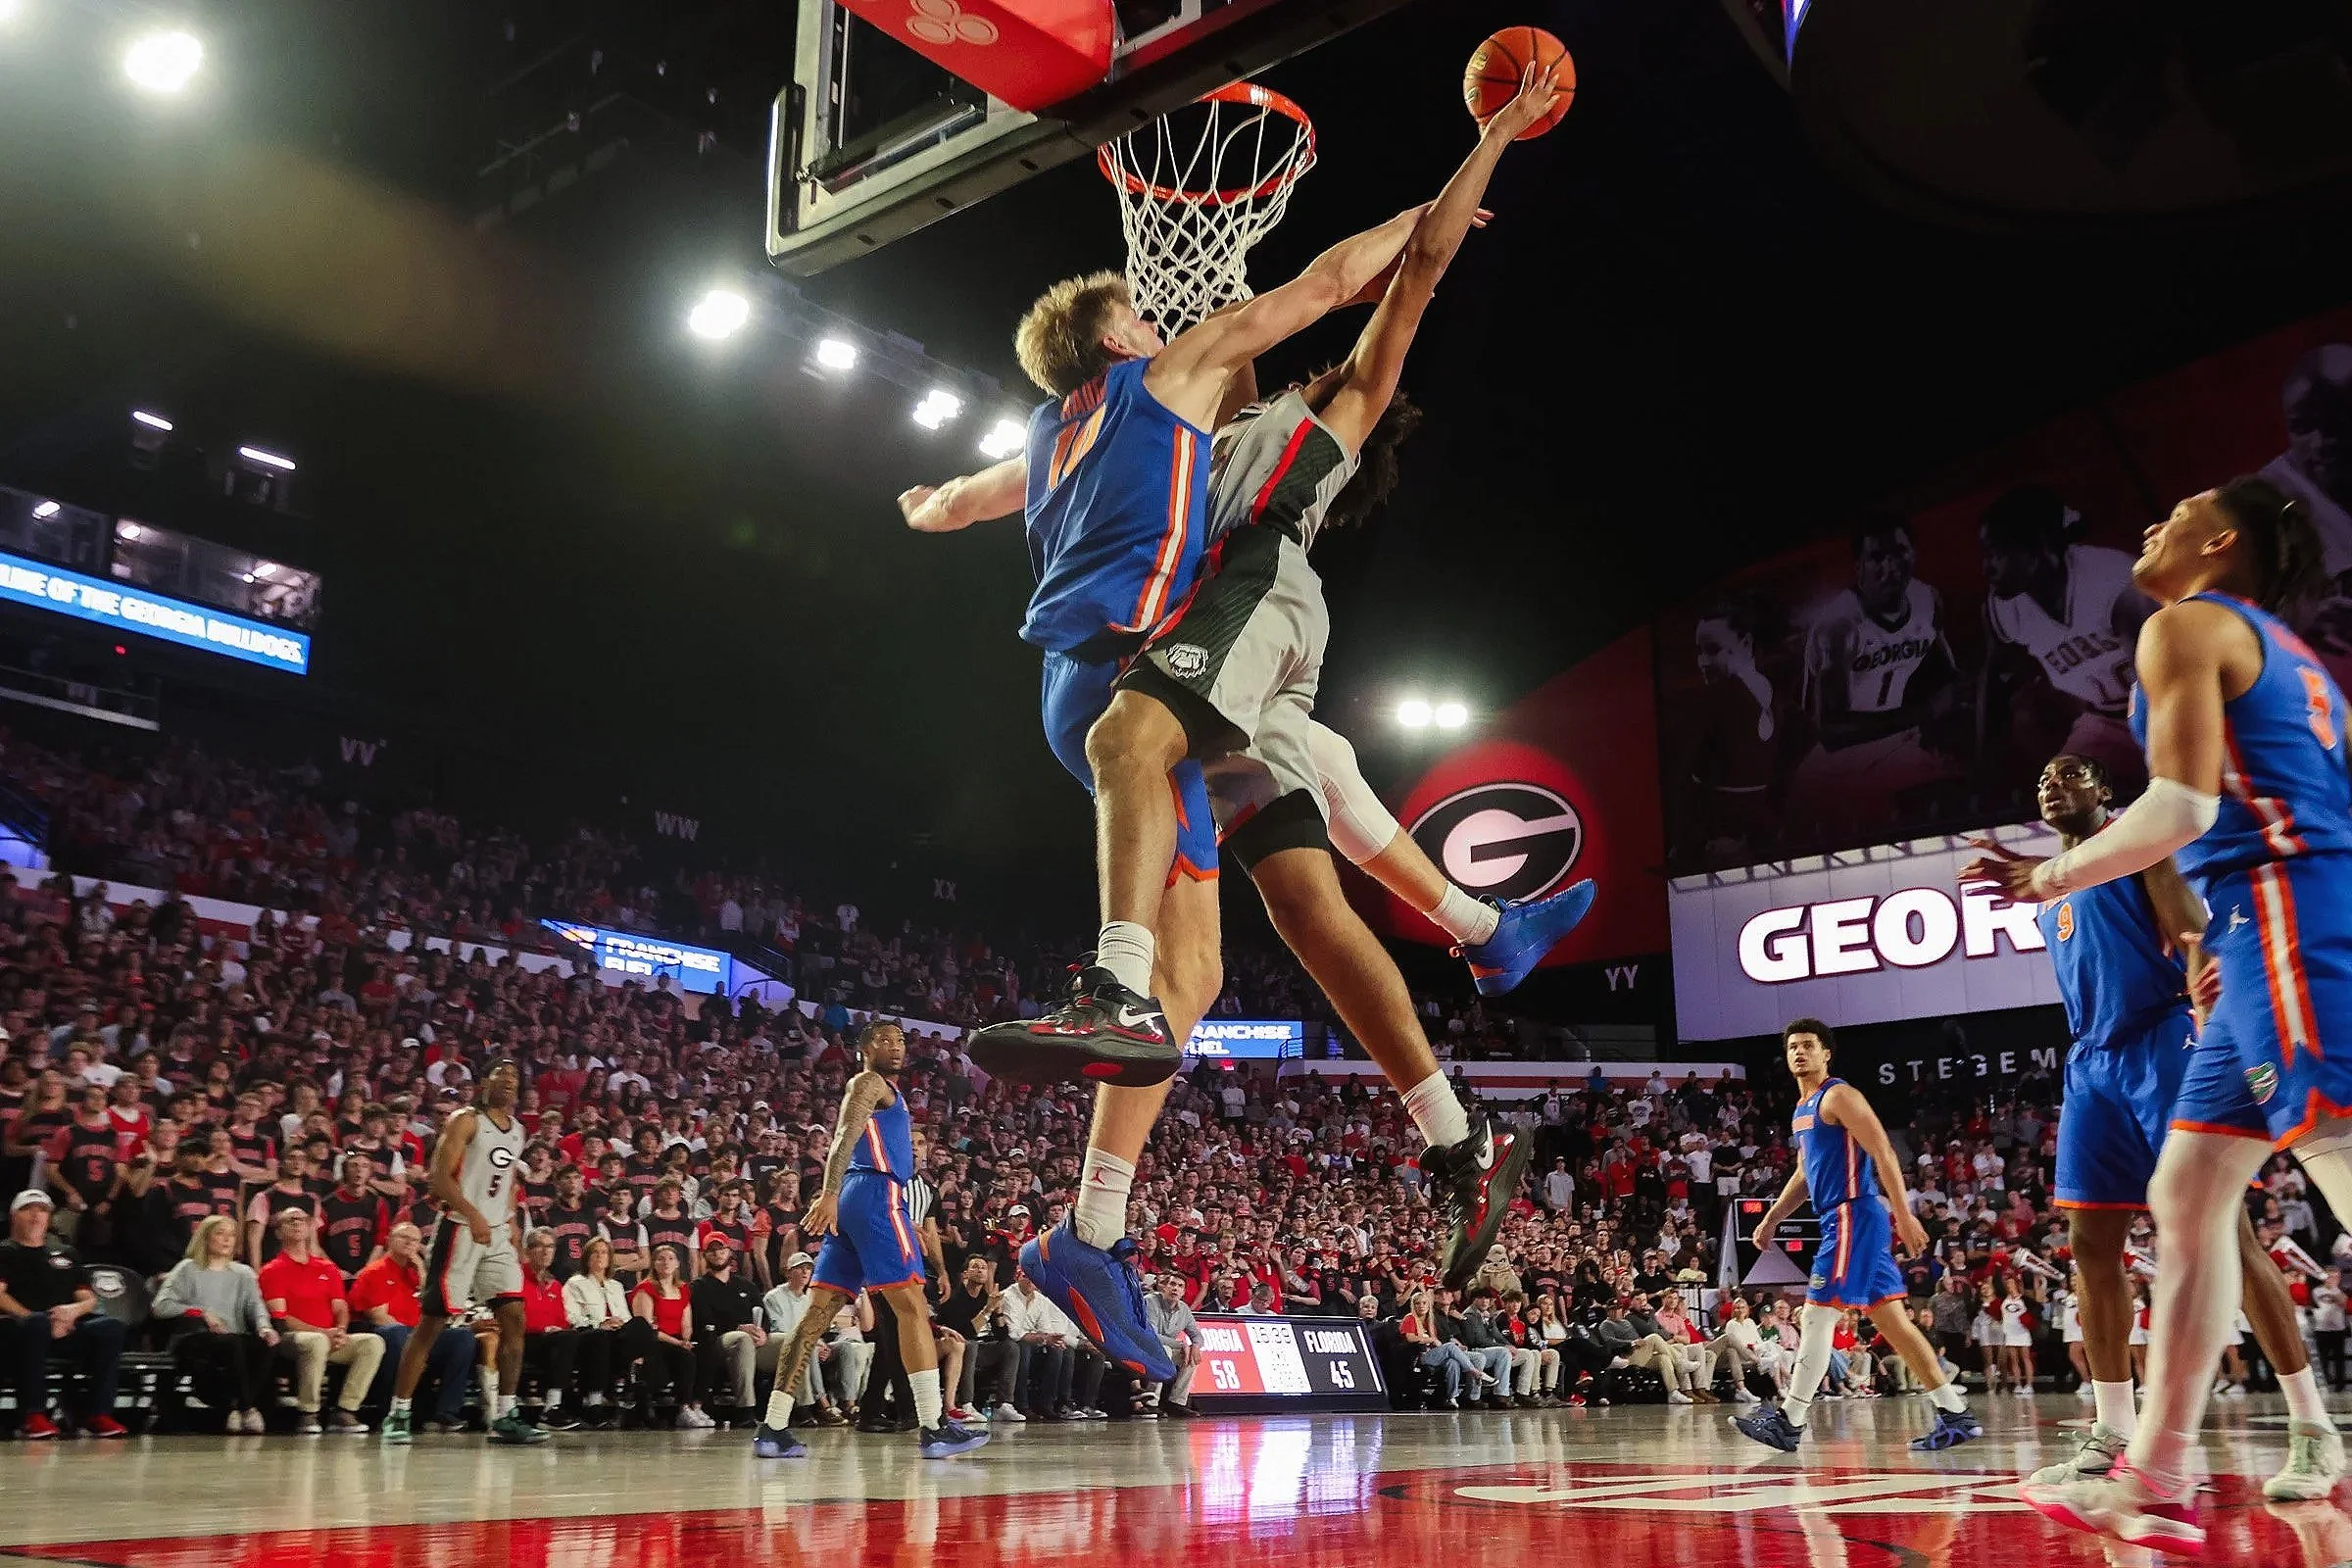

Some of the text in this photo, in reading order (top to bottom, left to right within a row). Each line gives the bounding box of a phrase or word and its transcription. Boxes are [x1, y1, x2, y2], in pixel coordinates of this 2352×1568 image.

[120, 597, 207, 639] GEORGIA
[1877, 670, 1893, 707] 1
[655, 809, 699, 843] WW
[1739, 887, 2047, 983] GEOR
[2057, 902, 2075, 943] 9
[1604, 964, 1639, 992] YY
[1191, 1024, 1293, 1040] RANCHISE
[1878, 1048, 2058, 1085] STEGEM
[490, 1146, 513, 1169] G
[488, 1174, 502, 1199] 5
[568, 1238, 582, 1259] 5
[1200, 1328, 1246, 1351] ORGIA
[1302, 1330, 1358, 1353] FLORIDA
[1209, 1359, 1241, 1390] 58
[1329, 1359, 1355, 1389] 45
